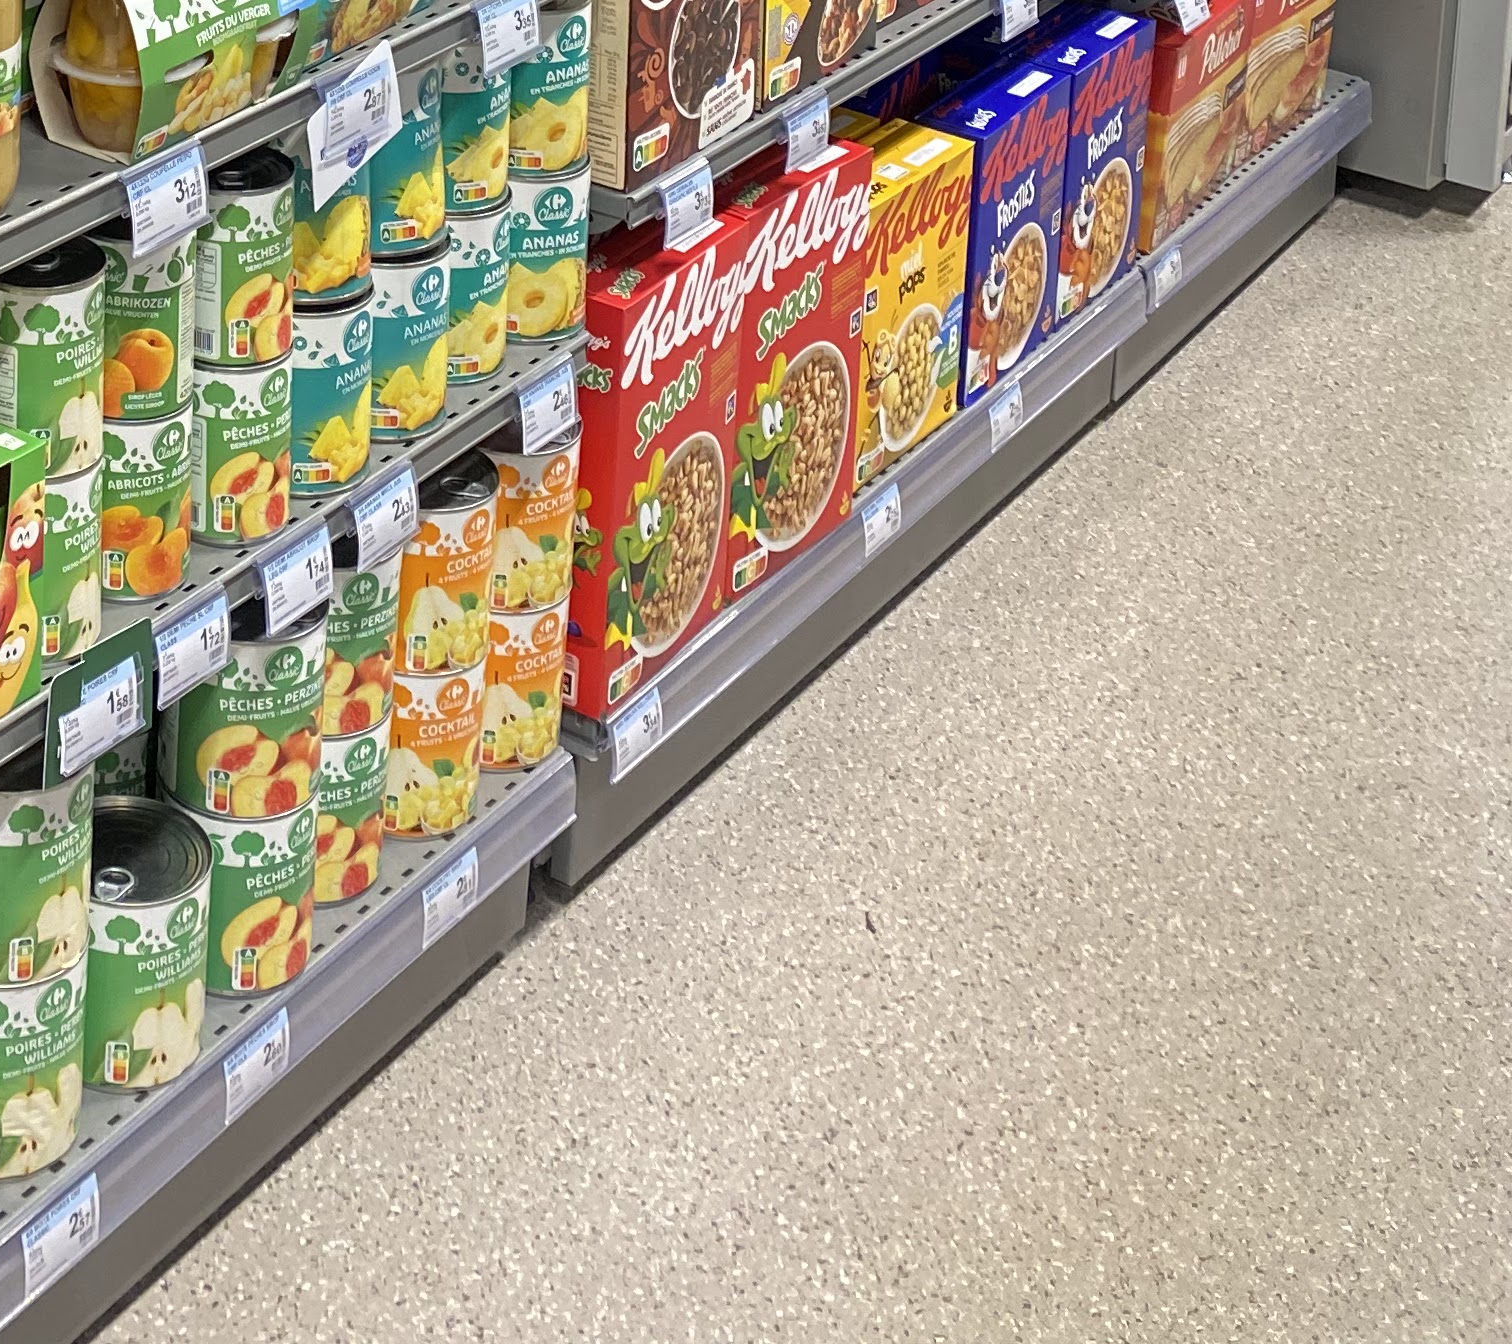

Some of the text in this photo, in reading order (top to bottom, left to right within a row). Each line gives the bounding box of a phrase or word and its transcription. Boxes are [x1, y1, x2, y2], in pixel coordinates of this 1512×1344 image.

[196, 3, 271, 47] FRUITS DU VERGER
[1086, 107, 1124, 163] FROSTIES
[996, 177, 1036, 236] FROSTIES
[523, 231, 580, 250] ANANAS
[106, 295, 172, 309] ABRIKOZEN
[107, 474, 164, 490] ABRICOTS
[23, 1041, 77, 1067] WILLIAMS
